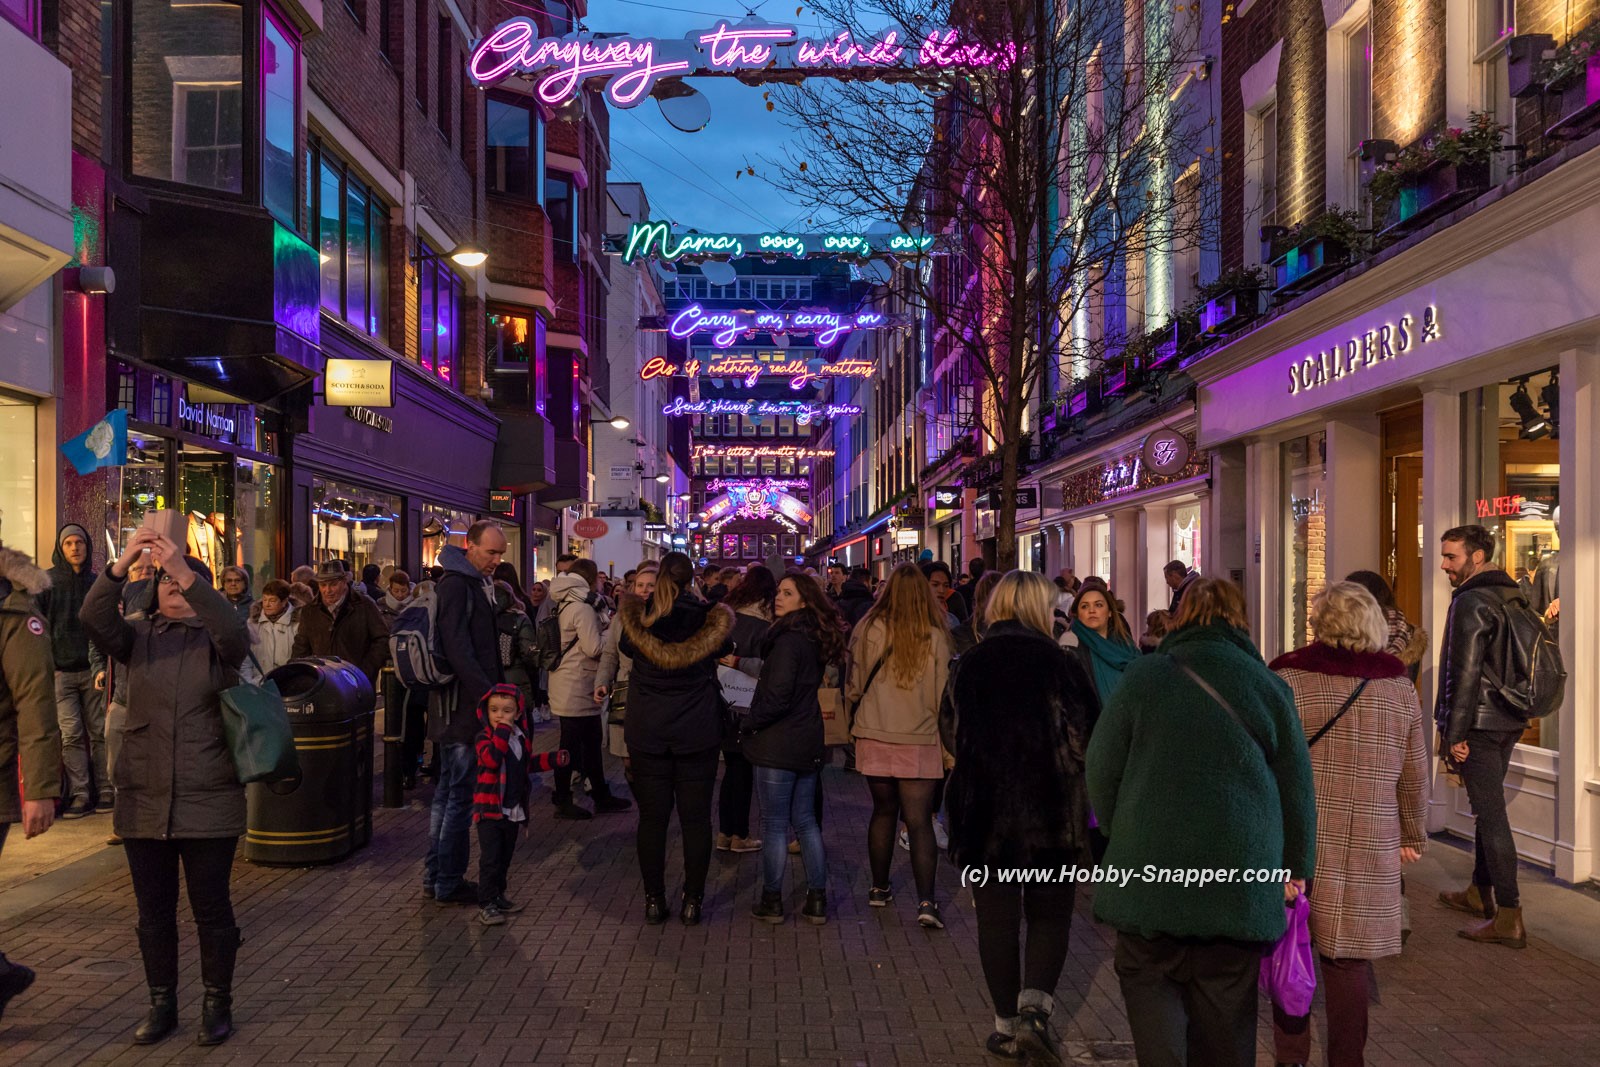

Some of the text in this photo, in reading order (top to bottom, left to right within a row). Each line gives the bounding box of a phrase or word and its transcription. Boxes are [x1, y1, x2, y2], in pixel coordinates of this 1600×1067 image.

[470, 20, 689, 104] Anyway
[700, 24, 793, 67] the
[797, 30, 903, 65] wind
[624, 222, 743, 263] Mama,
[670, 304, 881, 345] Carry on, carry on
[641, 356, 877, 389] As if nothing really matters
[1286, 316, 1411, 395] SCALPERS
[178, 397, 234, 433] David Naman
[662, 398, 860, 425] Send shivers down my spine
[691, 444, 703, 459] I
[717, 449, 725, 457] a
[726, 446, 753, 457] little
[807, 449, 816, 457] a
[816, 450, 836, 458] man
[576, 523, 606, 535] benefit
[723, 682, 755, 693] MANGO
